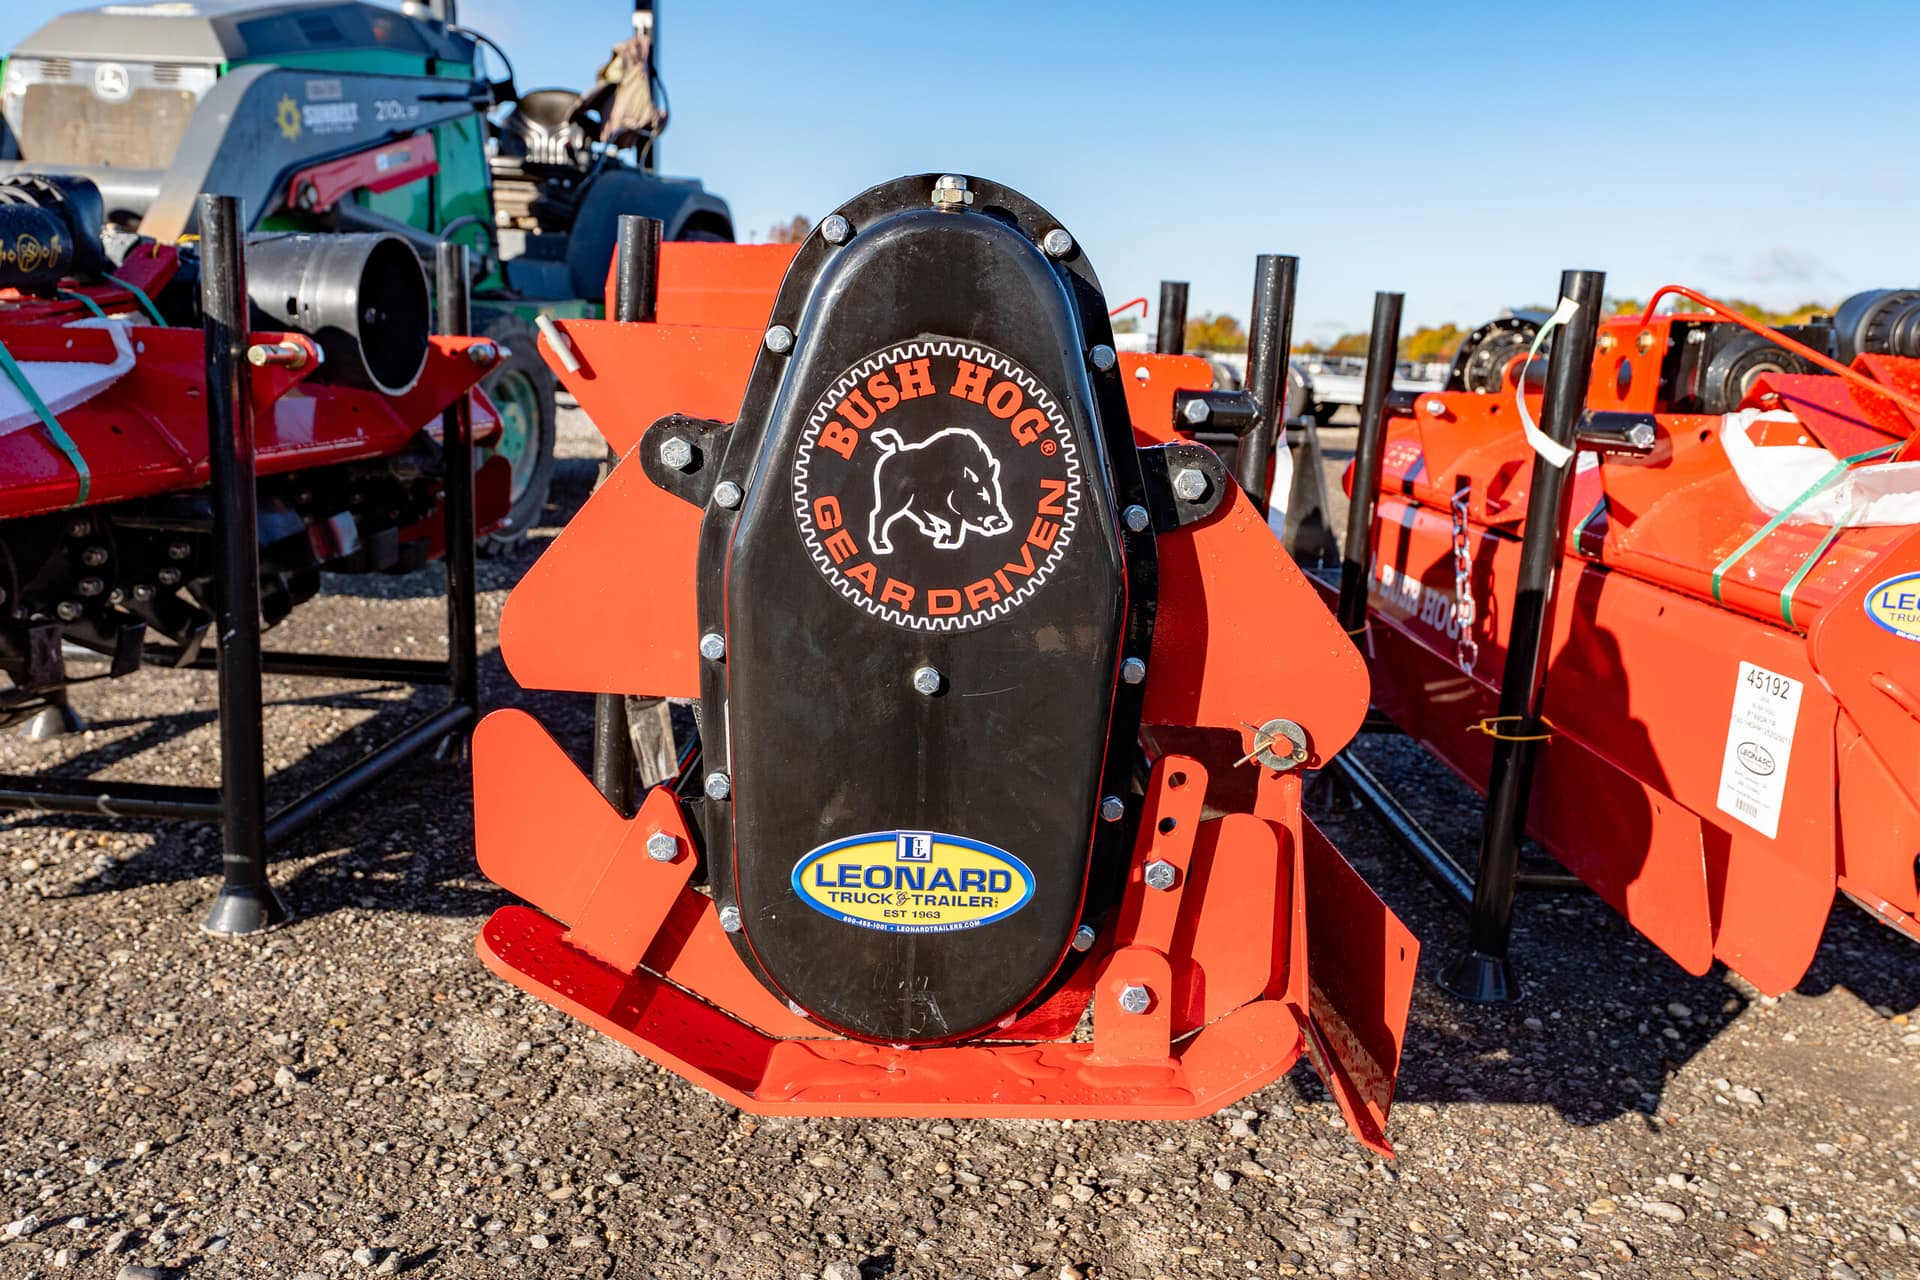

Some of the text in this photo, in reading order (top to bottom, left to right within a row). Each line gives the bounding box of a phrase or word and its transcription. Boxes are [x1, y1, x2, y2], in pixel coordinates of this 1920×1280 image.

[818, 358, 937, 461] BUSH
[813, 478, 1067, 615] GEAR DRIVEN
[1747, 668, 1790, 700] 45192
[815, 863, 1012, 893] LEONARD
[828, 891, 893, 905] TRUCK
[912, 893, 993, 908] TRAILER
[883, 909, 941, 919] EST 1963
